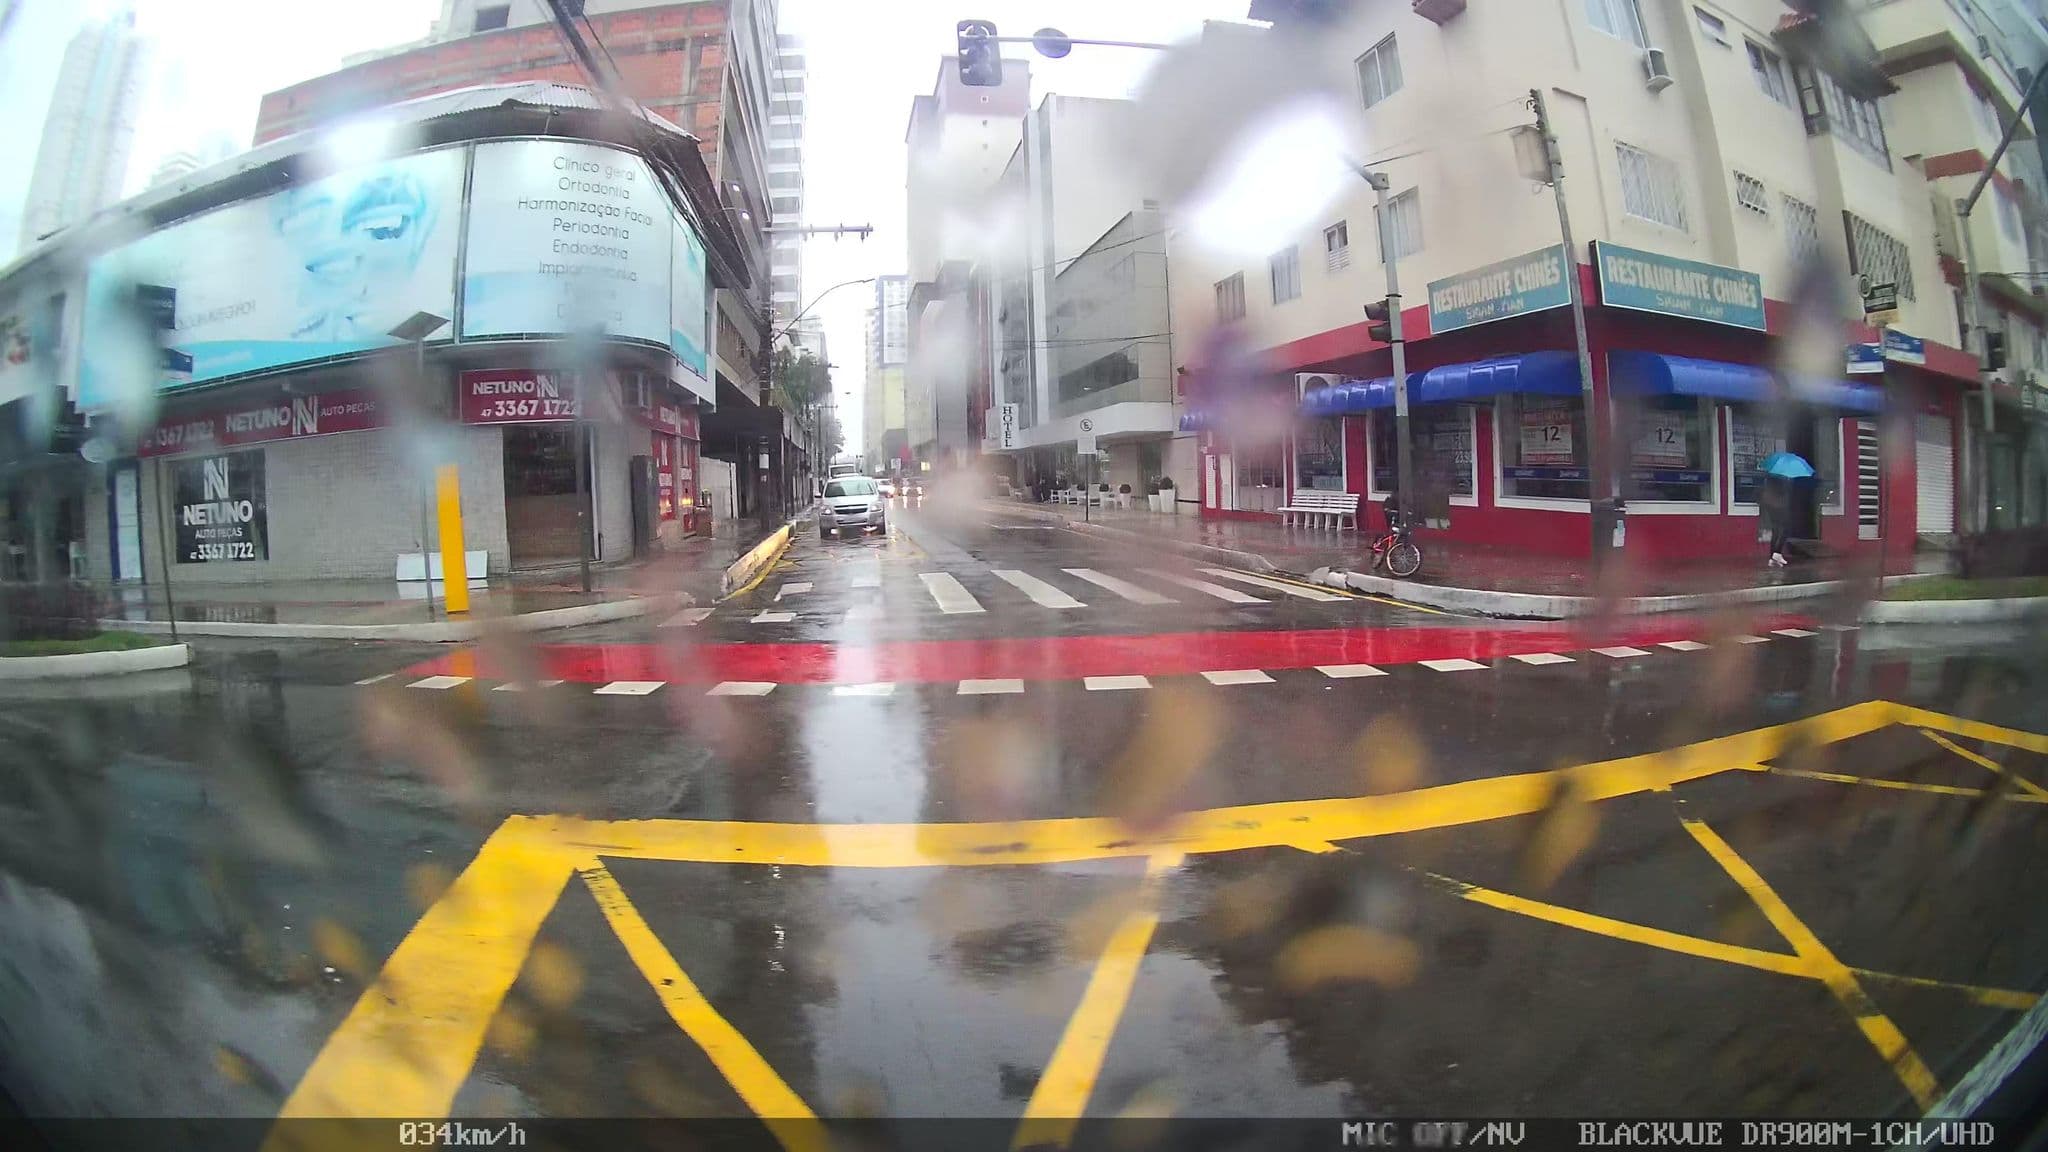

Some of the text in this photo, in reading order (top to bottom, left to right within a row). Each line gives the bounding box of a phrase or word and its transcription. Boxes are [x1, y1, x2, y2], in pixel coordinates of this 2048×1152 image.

[558, 176, 630, 200] Ortodontia
[517, 195, 653, 226] Harmonização Facial
[553, 217, 630, 240] Periodontia
[552, 238, 629, 260] Endodontia
[1606, 255, 1711, 299] RESTAURANTE
[1433, 271, 1513, 314] RESTAURANTE
[472, 381, 536, 395] NETUNO
[225, 406, 292, 434] NETUNO
[320, 405, 345, 417] AUTO
[495, 400, 539, 417] 3367
[1003, 406, 1013, 447] HOTEL
[1541, 426, 1561, 441] 12
[1656, 428, 1675, 444] 12
[184, 501, 253, 526] NETUNO
[198, 544, 225, 559] 3367
[227, 542, 254, 558] 1722
